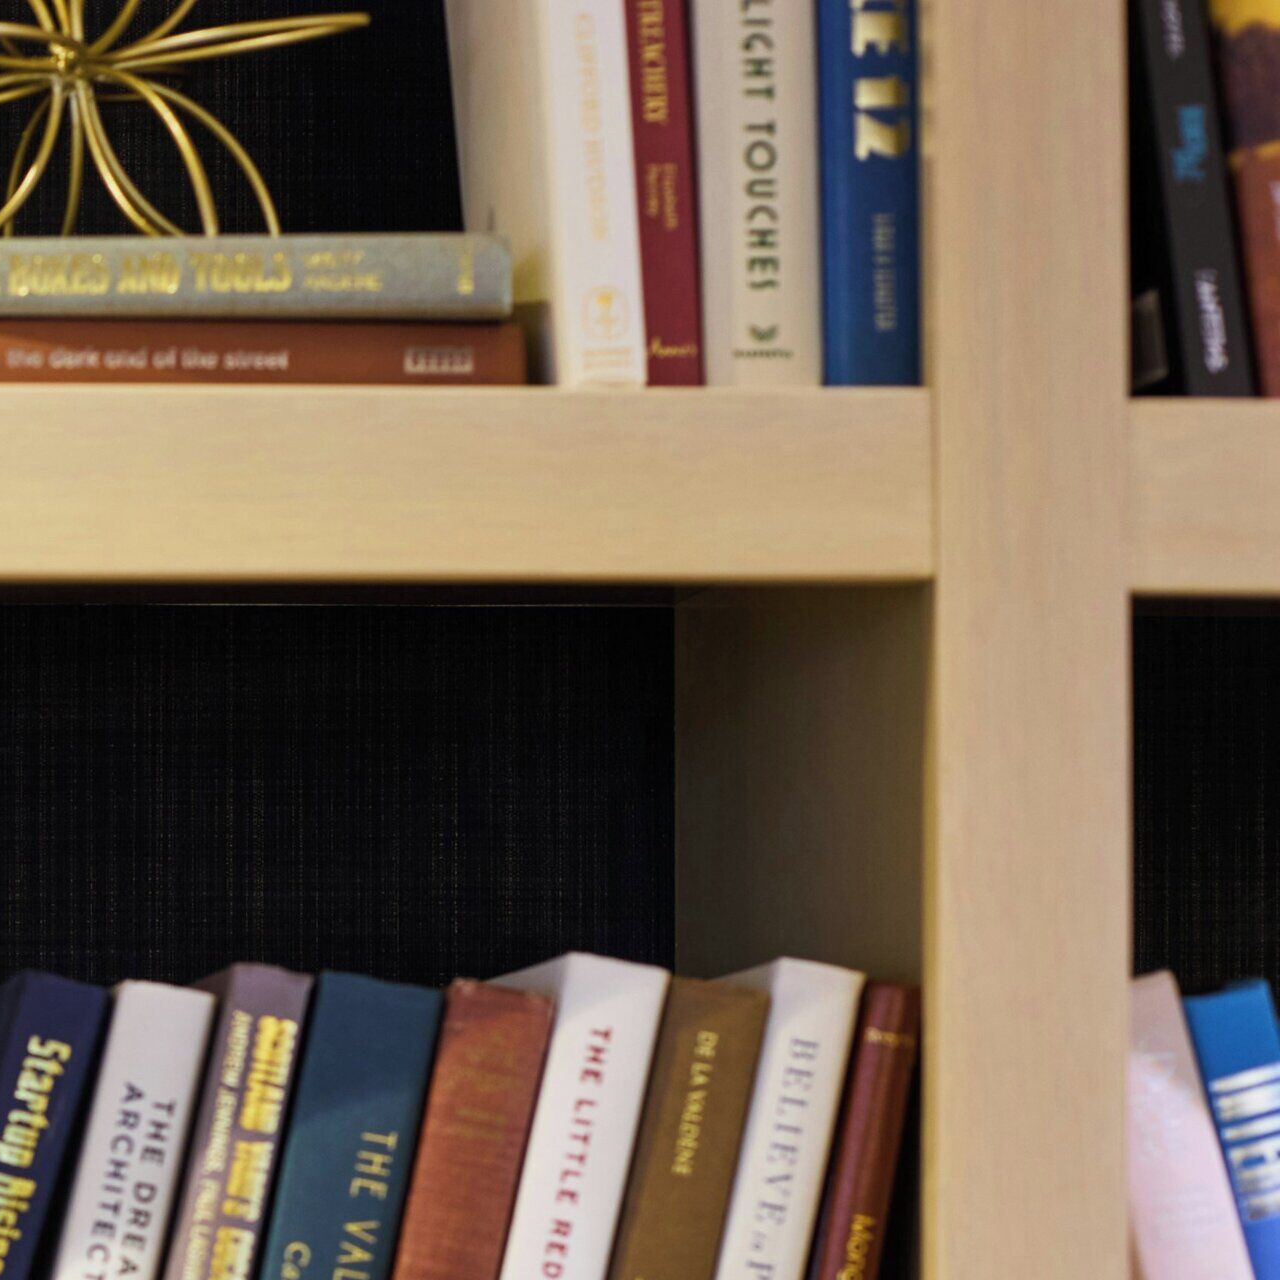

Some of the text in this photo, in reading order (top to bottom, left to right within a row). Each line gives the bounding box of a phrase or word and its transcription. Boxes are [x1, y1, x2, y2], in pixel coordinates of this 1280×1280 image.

[743, 119, 780, 291] TOUCHES
[8, 254, 111, 297] BOXES
[116, 252, 181, 295] AND
[189, 250, 293, 294] TOOLS
[6, 346, 290, 371] the dark end of the street
[217, 1008, 254, 1088] ANDREW
[236, 1013, 298, 1136] SCOTLAND
[578, 1022, 612, 1086] THE
[686, 1059, 713, 1089] LA
[692, 1028, 720, 1059] DE
[139, 1096, 177, 1167] THE
[346, 1125, 399, 1203] THE
[553, 1096, 597, 1207] LITTLE
[755, 1036, 821, 1227] BELIEVE
